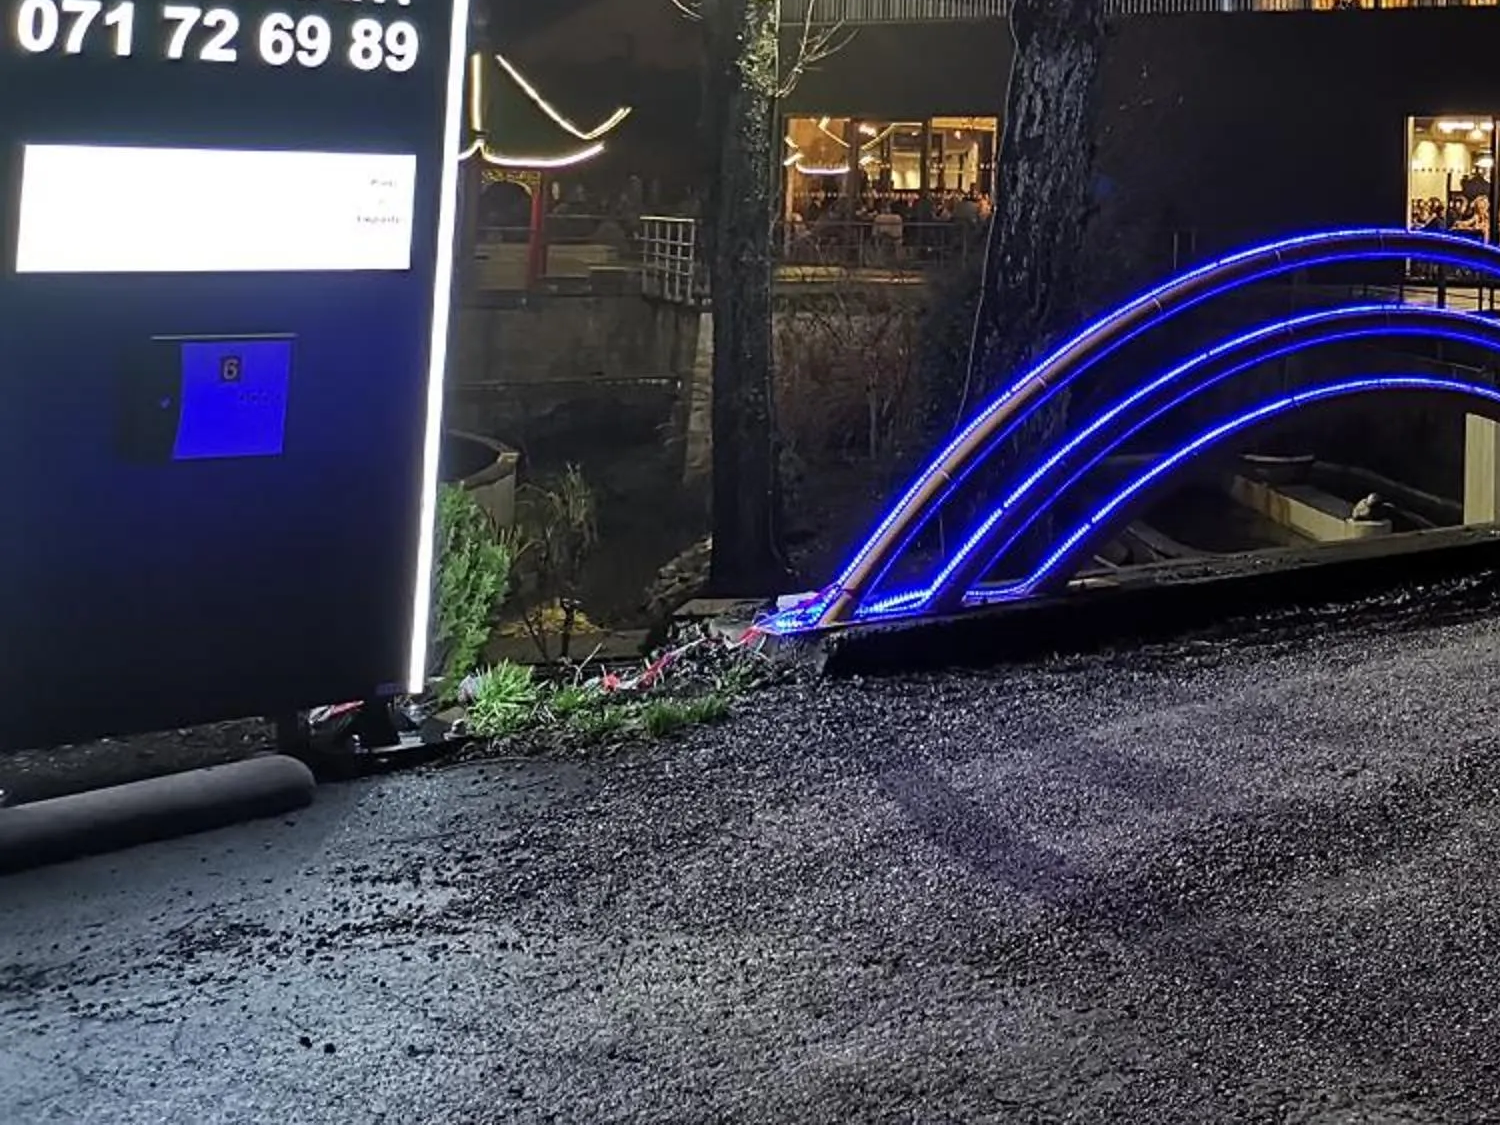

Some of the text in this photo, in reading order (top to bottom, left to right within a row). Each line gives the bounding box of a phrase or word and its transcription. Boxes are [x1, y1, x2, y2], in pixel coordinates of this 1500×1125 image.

[163, 5, 240, 62] 72
[258, 12, 332, 68] 69
[348, 18, 419, 72] 89
